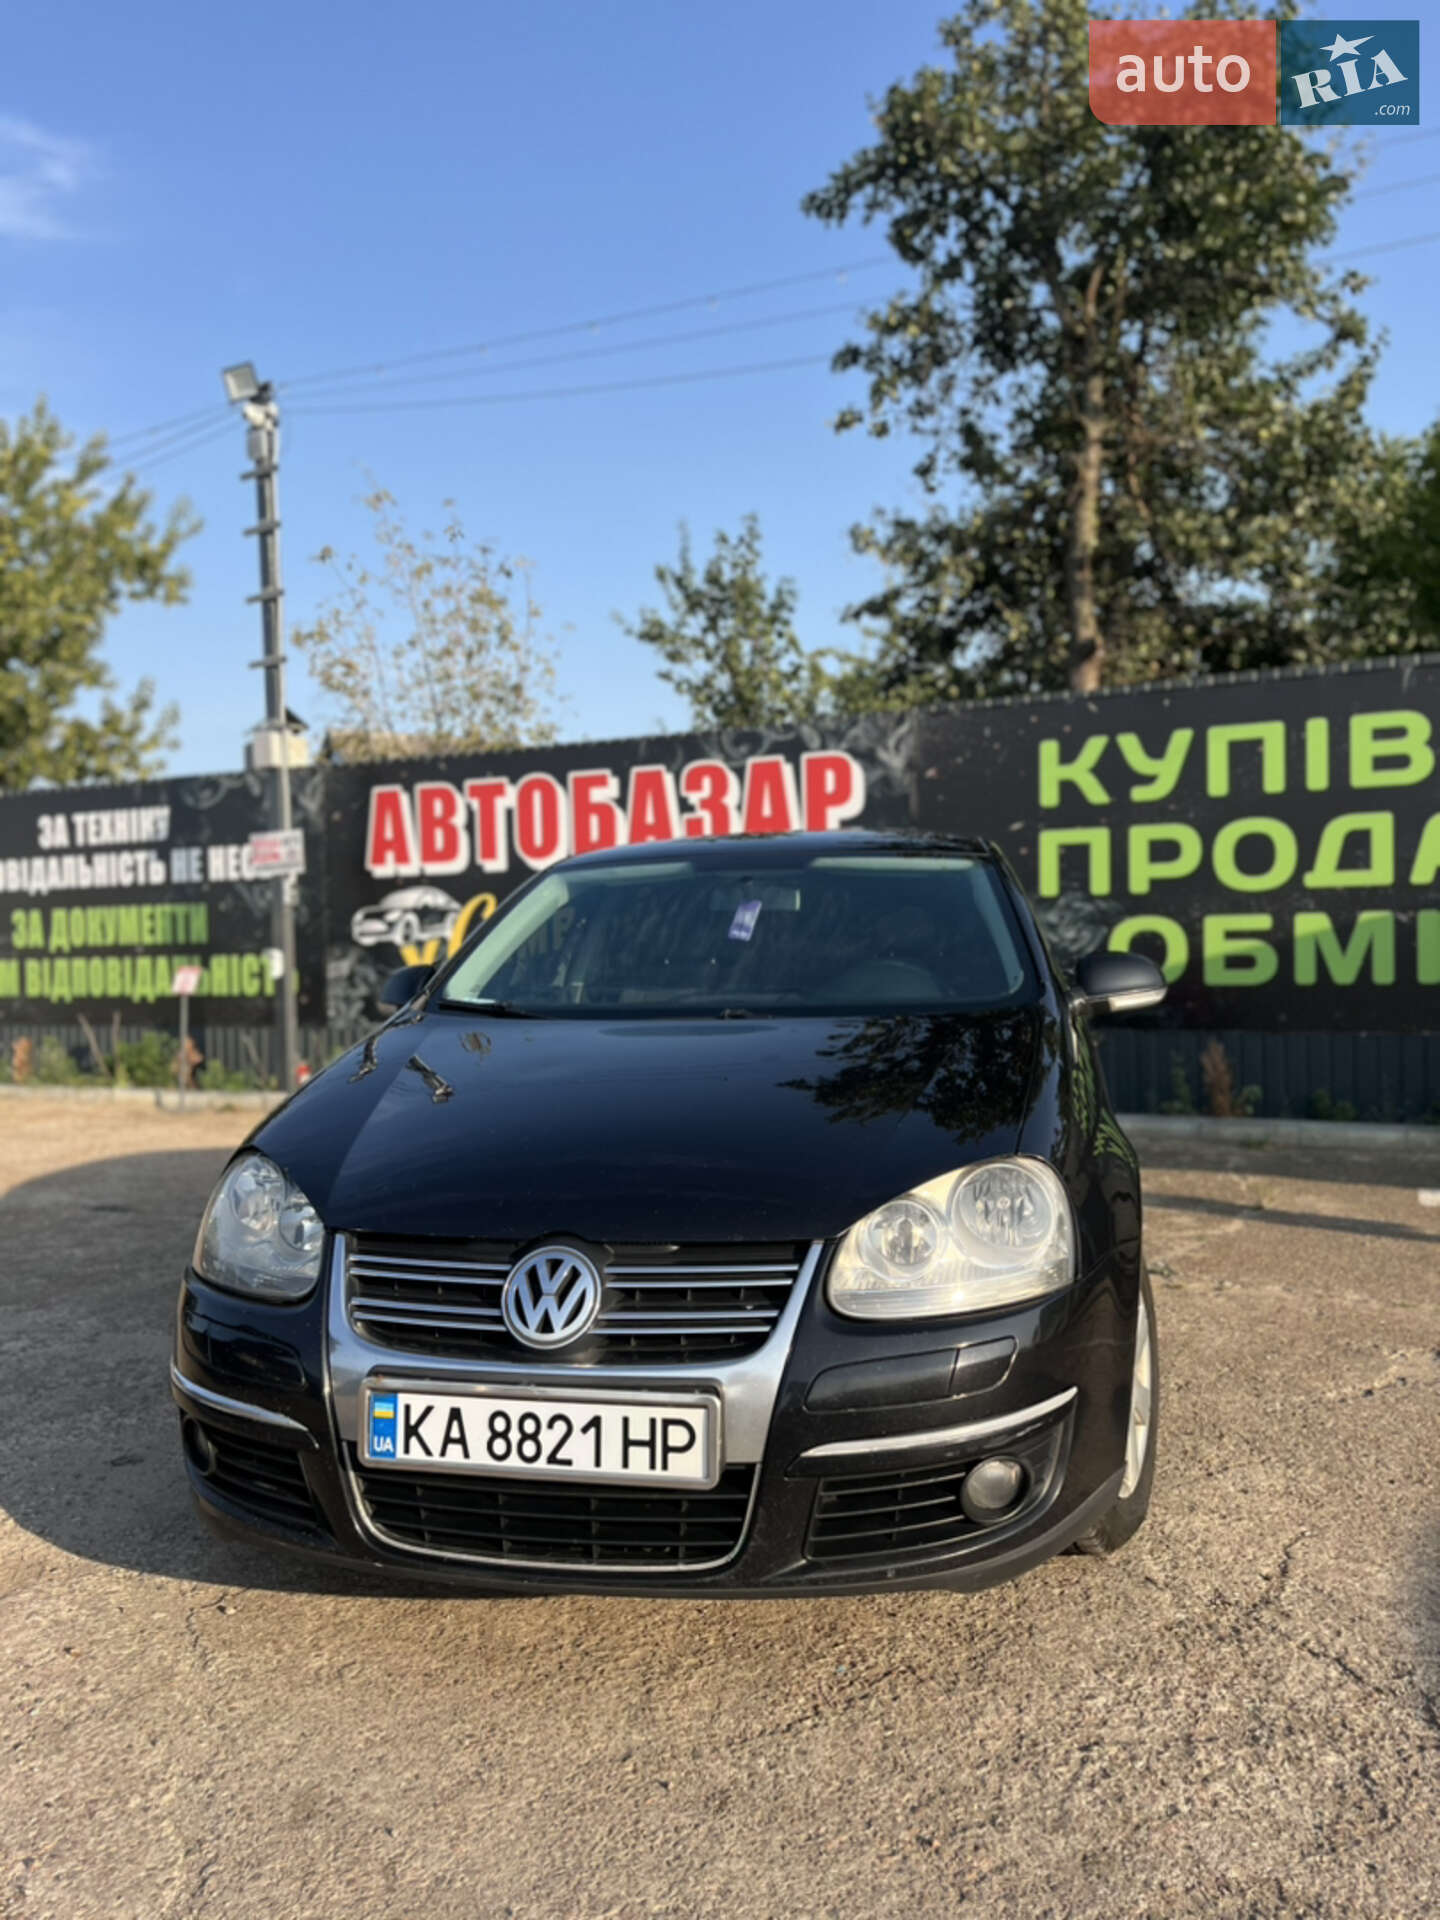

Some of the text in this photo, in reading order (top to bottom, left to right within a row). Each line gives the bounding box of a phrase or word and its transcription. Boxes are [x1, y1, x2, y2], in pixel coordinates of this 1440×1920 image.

[1038, 710, 1436, 808] КУПІВ
[37, 813, 69, 850] ЗА
[365, 750, 866, 878] АВТОБАЗАР
[0, 849, 167, 897] ВІДАЛЬНІСТЬ
[171, 846, 203, 883] НЕ
[11, 907, 45, 950] ЗА
[373, 1436, 395, 1452] UA
[403, 1404, 697, 1471] KA 8821 HP
